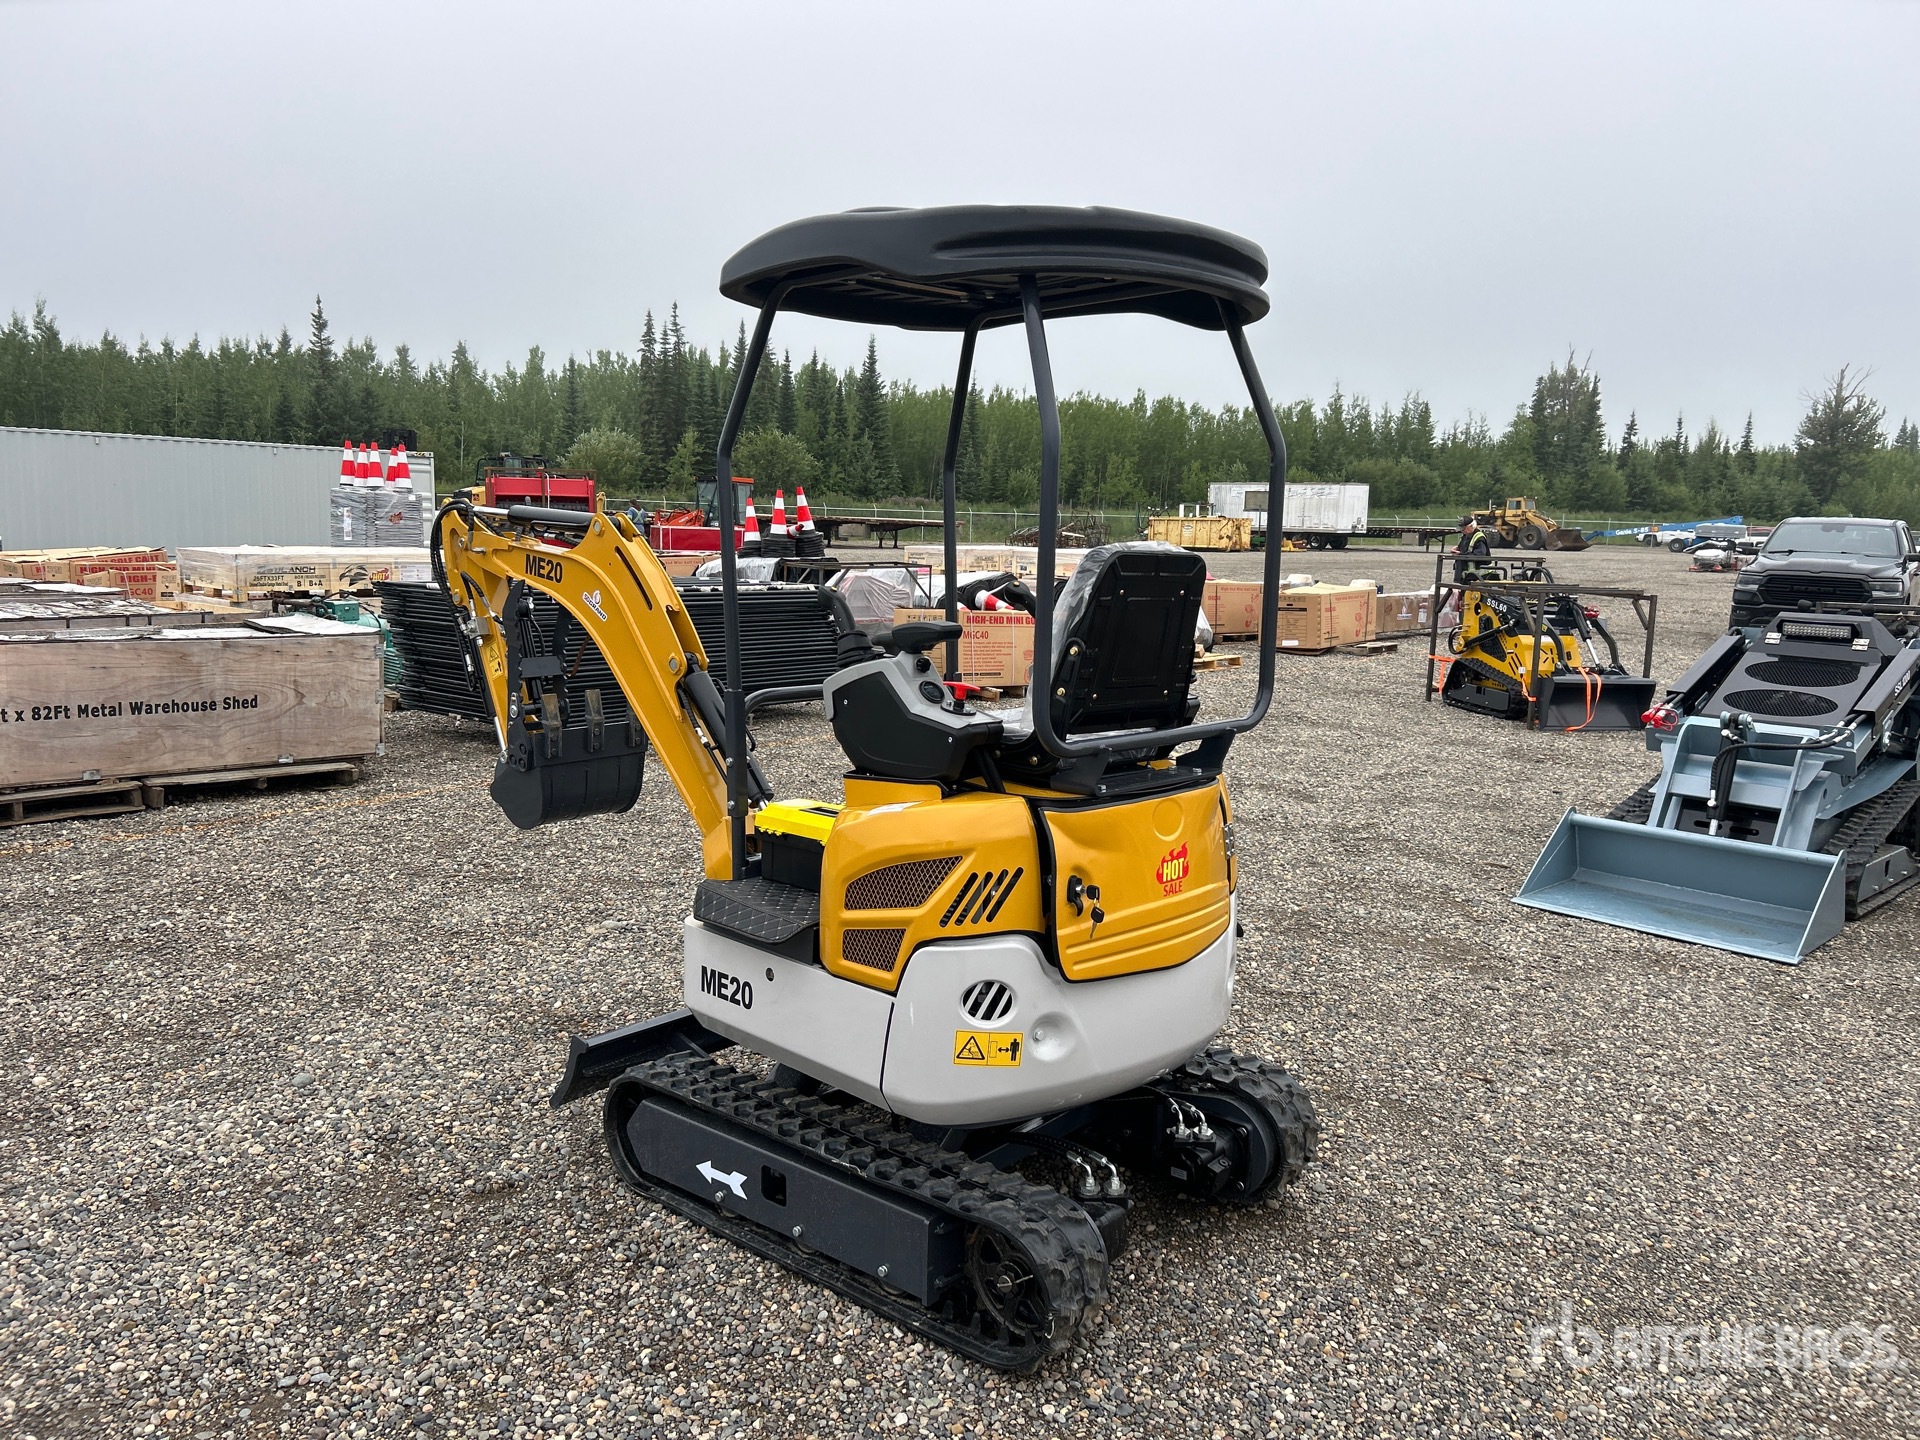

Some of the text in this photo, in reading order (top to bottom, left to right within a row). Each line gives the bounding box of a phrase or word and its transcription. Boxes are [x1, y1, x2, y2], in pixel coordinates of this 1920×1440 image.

[525, 553, 563, 584] ME20
[1486, 598, 1508, 613] SSL60
[966, 615, 1005, 625] HIGH-END
[1005, 615, 1024, 625] MINI
[963, 630, 989, 640] MGC40
[14, 710, 26, 723] x
[30, 704, 71, 721] 82Ft
[77, 702, 123, 719] Metal
[129, 699, 218, 717] Warehouse
[222, 694, 259, 711] Shed
[1162, 857, 1185, 883] HOT
[1163, 880, 1183, 898] SALE
[701, 964, 754, 1010] ME20
